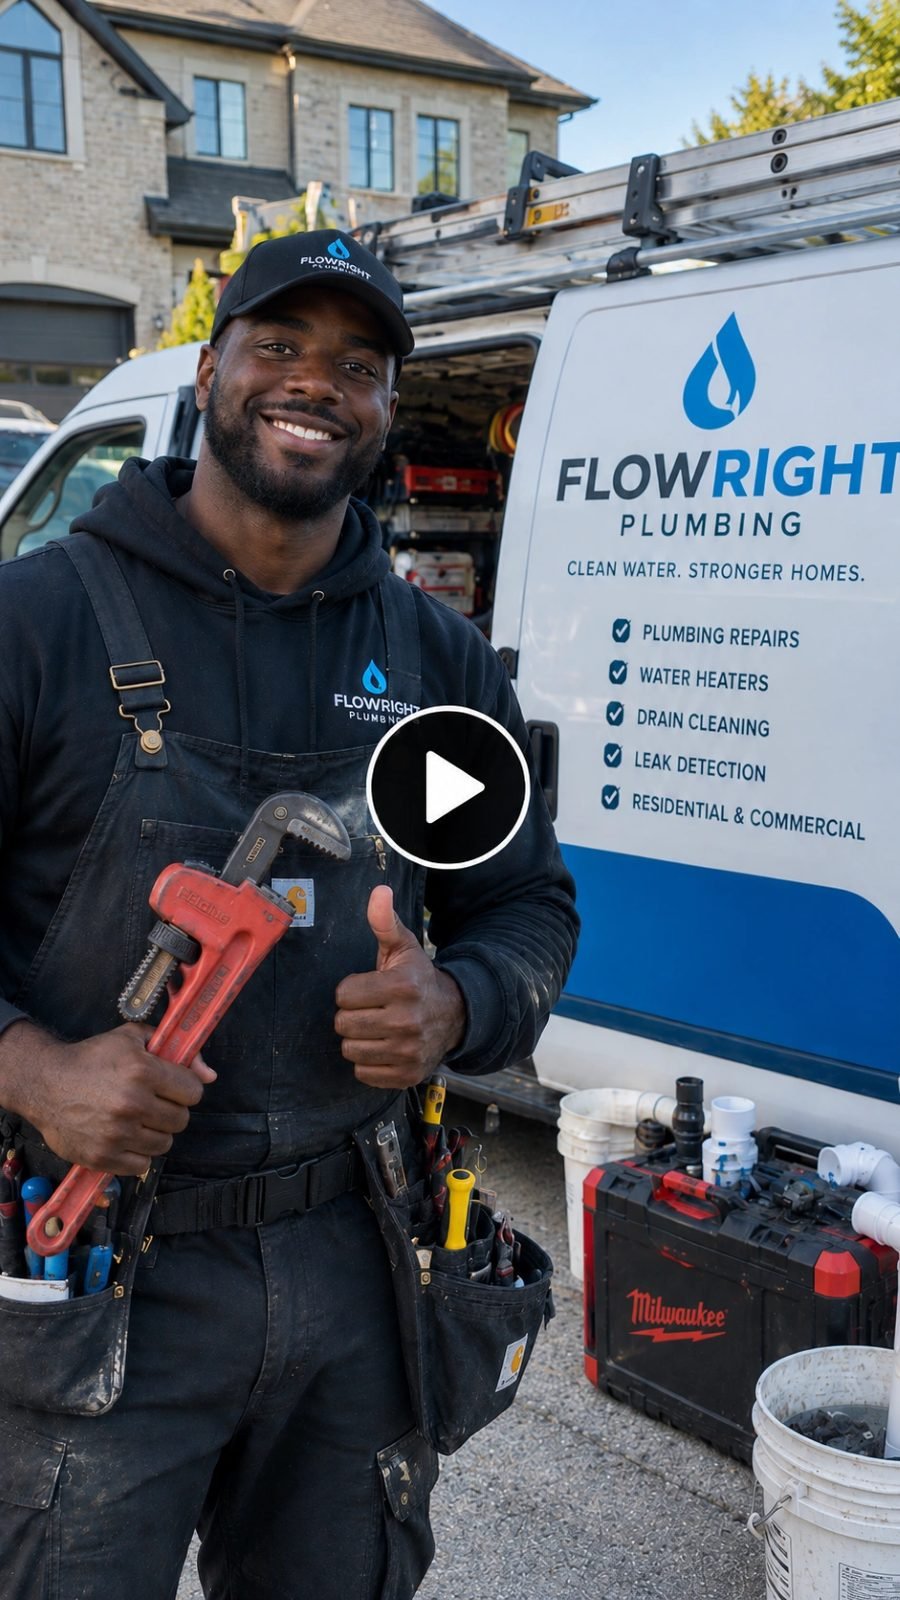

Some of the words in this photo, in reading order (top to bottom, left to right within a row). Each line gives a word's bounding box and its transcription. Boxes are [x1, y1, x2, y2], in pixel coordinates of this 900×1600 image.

[556, 441, 900, 501] FLOWRIGHT
[620, 511, 801, 537] PLUMBING
[567, 560, 617, 577] CLEAN
[623, 561, 681, 578] WATER.
[688, 562, 783, 580] STRONGER
[791, 564, 865, 582] HOMES.
[643, 624, 724, 645] PLUMBING
[730, 628, 800, 648] REPAIRS
[640, 667, 691, 686] WATER
[696, 670, 769, 692] HEATERS
[637, 708, 684, 729] DRAIN
[688, 713, 770, 738] CLEANING
[634, 751, 672, 771] LEAK
[677, 756, 766, 782] DETECTION
[632, 793, 728, 822] RESIDENTIAL
[733, 806, 745, 824] &
[750, 808, 865, 841] COMMERCIAL
[626, 1288, 726, 1328] Milwaukee
